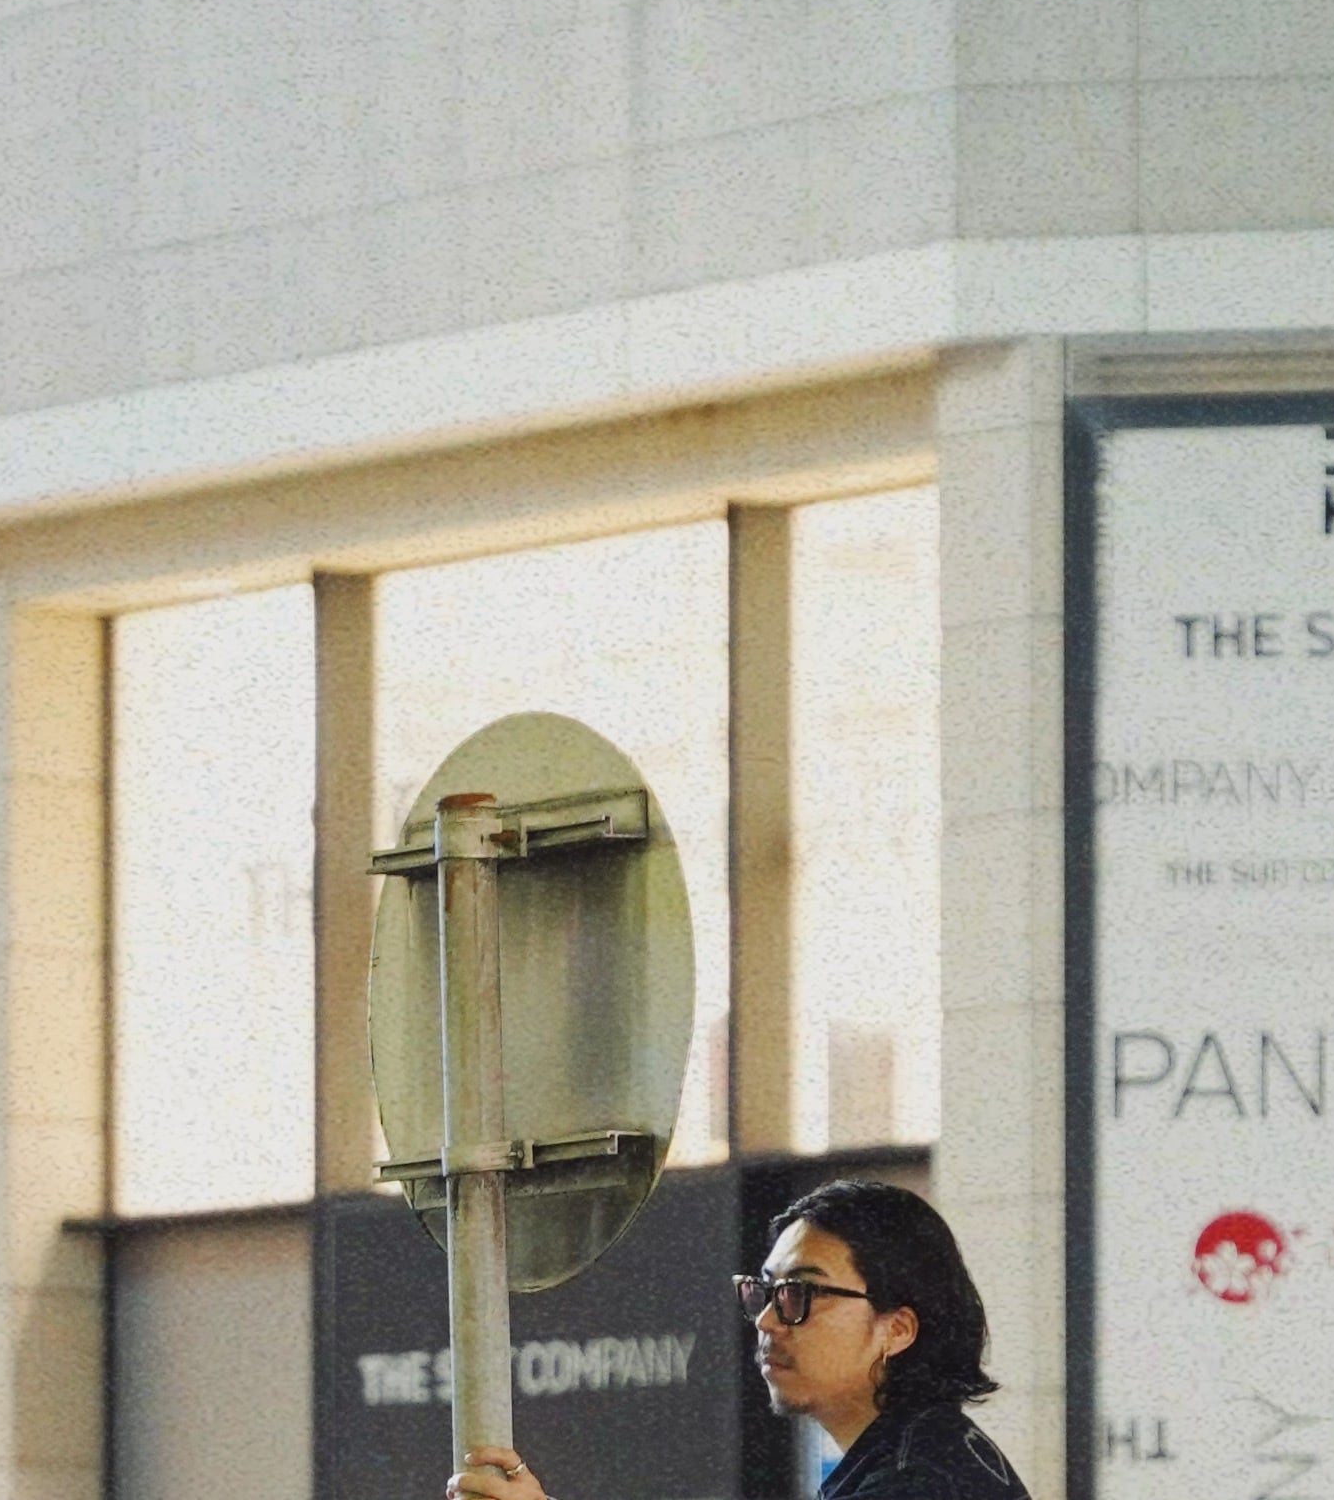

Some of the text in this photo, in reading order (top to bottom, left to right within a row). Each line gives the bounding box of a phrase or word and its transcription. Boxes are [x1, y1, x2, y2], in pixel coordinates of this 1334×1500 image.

[1174, 611, 1287, 660] THE
[357, 1349, 431, 1407] THE
[517, 1332, 697, 1397] COMPANY
